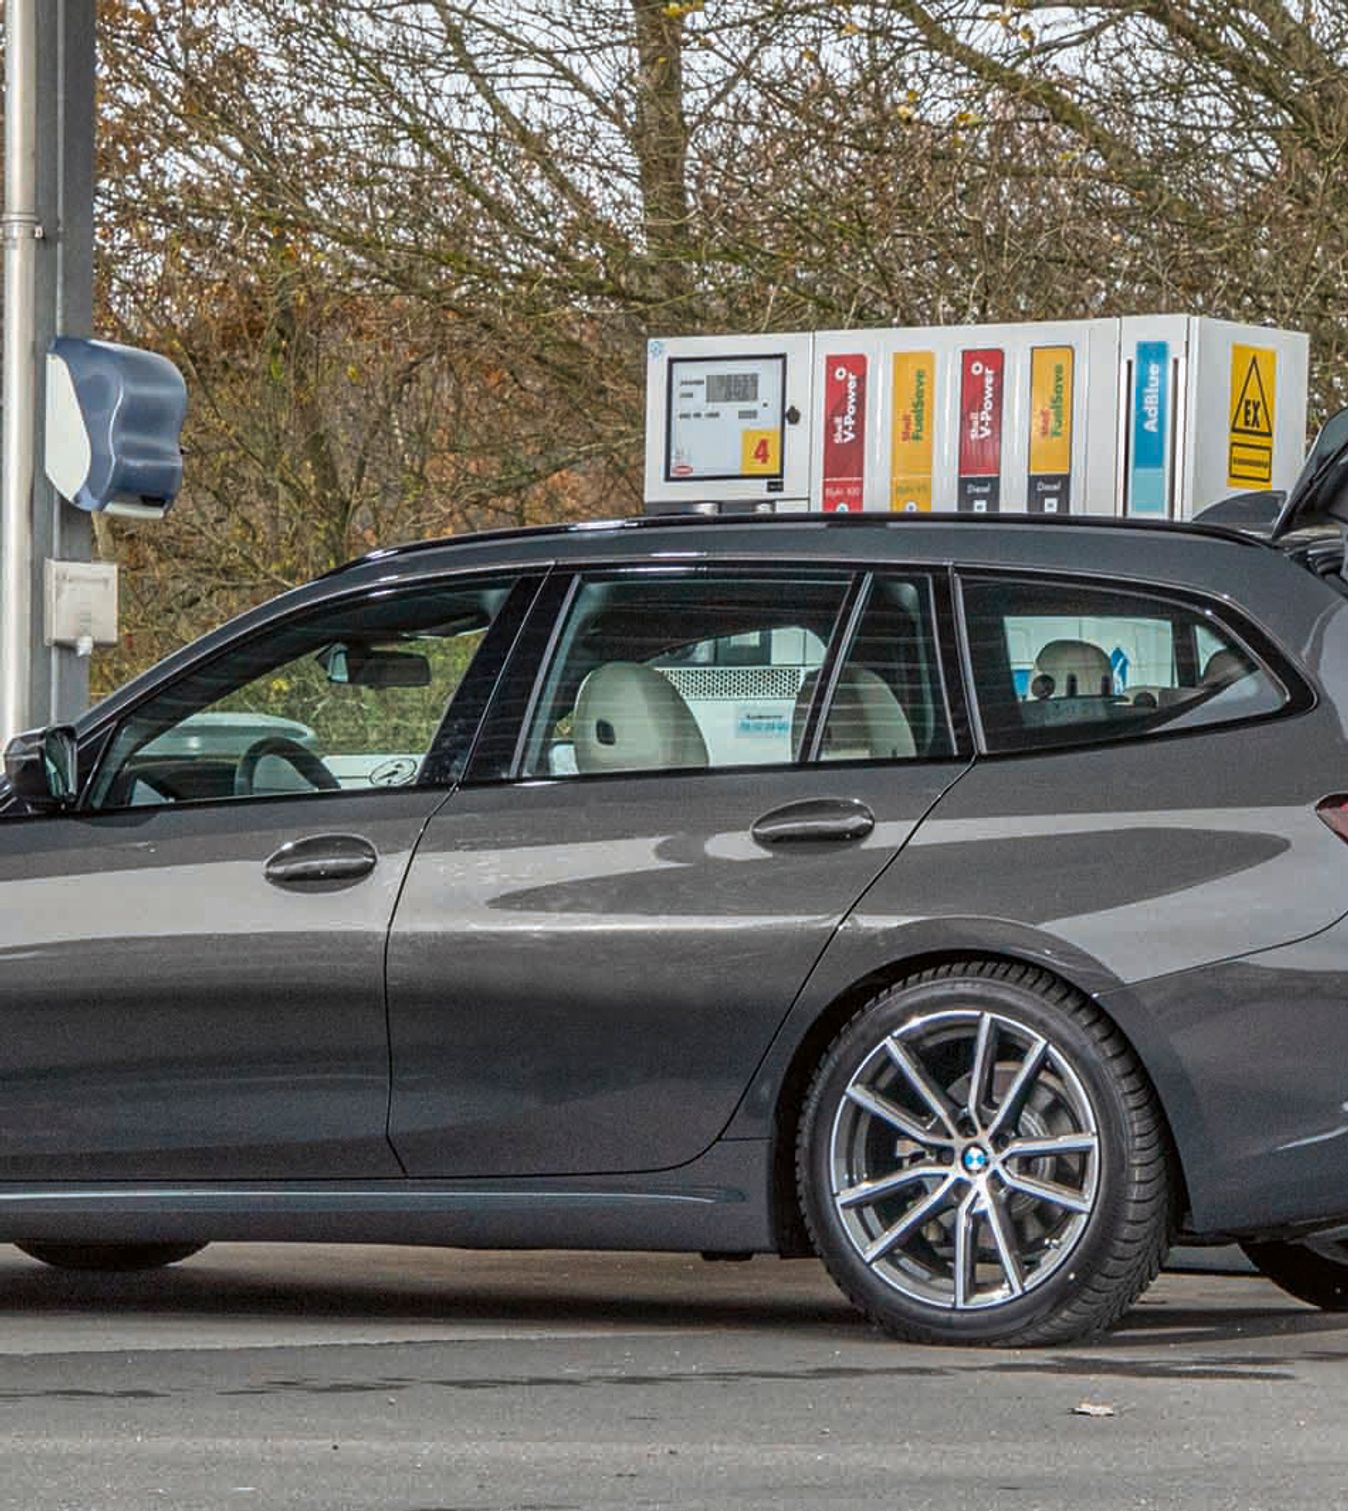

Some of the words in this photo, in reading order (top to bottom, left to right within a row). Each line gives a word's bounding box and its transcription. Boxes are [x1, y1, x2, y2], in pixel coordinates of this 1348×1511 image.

[843, 372, 857, 443] V-Power
[980, 367, 994, 439] V-Power
[1143, 363, 1159, 432] AdBlue
[1244, 399, 1261, 428] EX
[753, 438, 770, 464] 4
